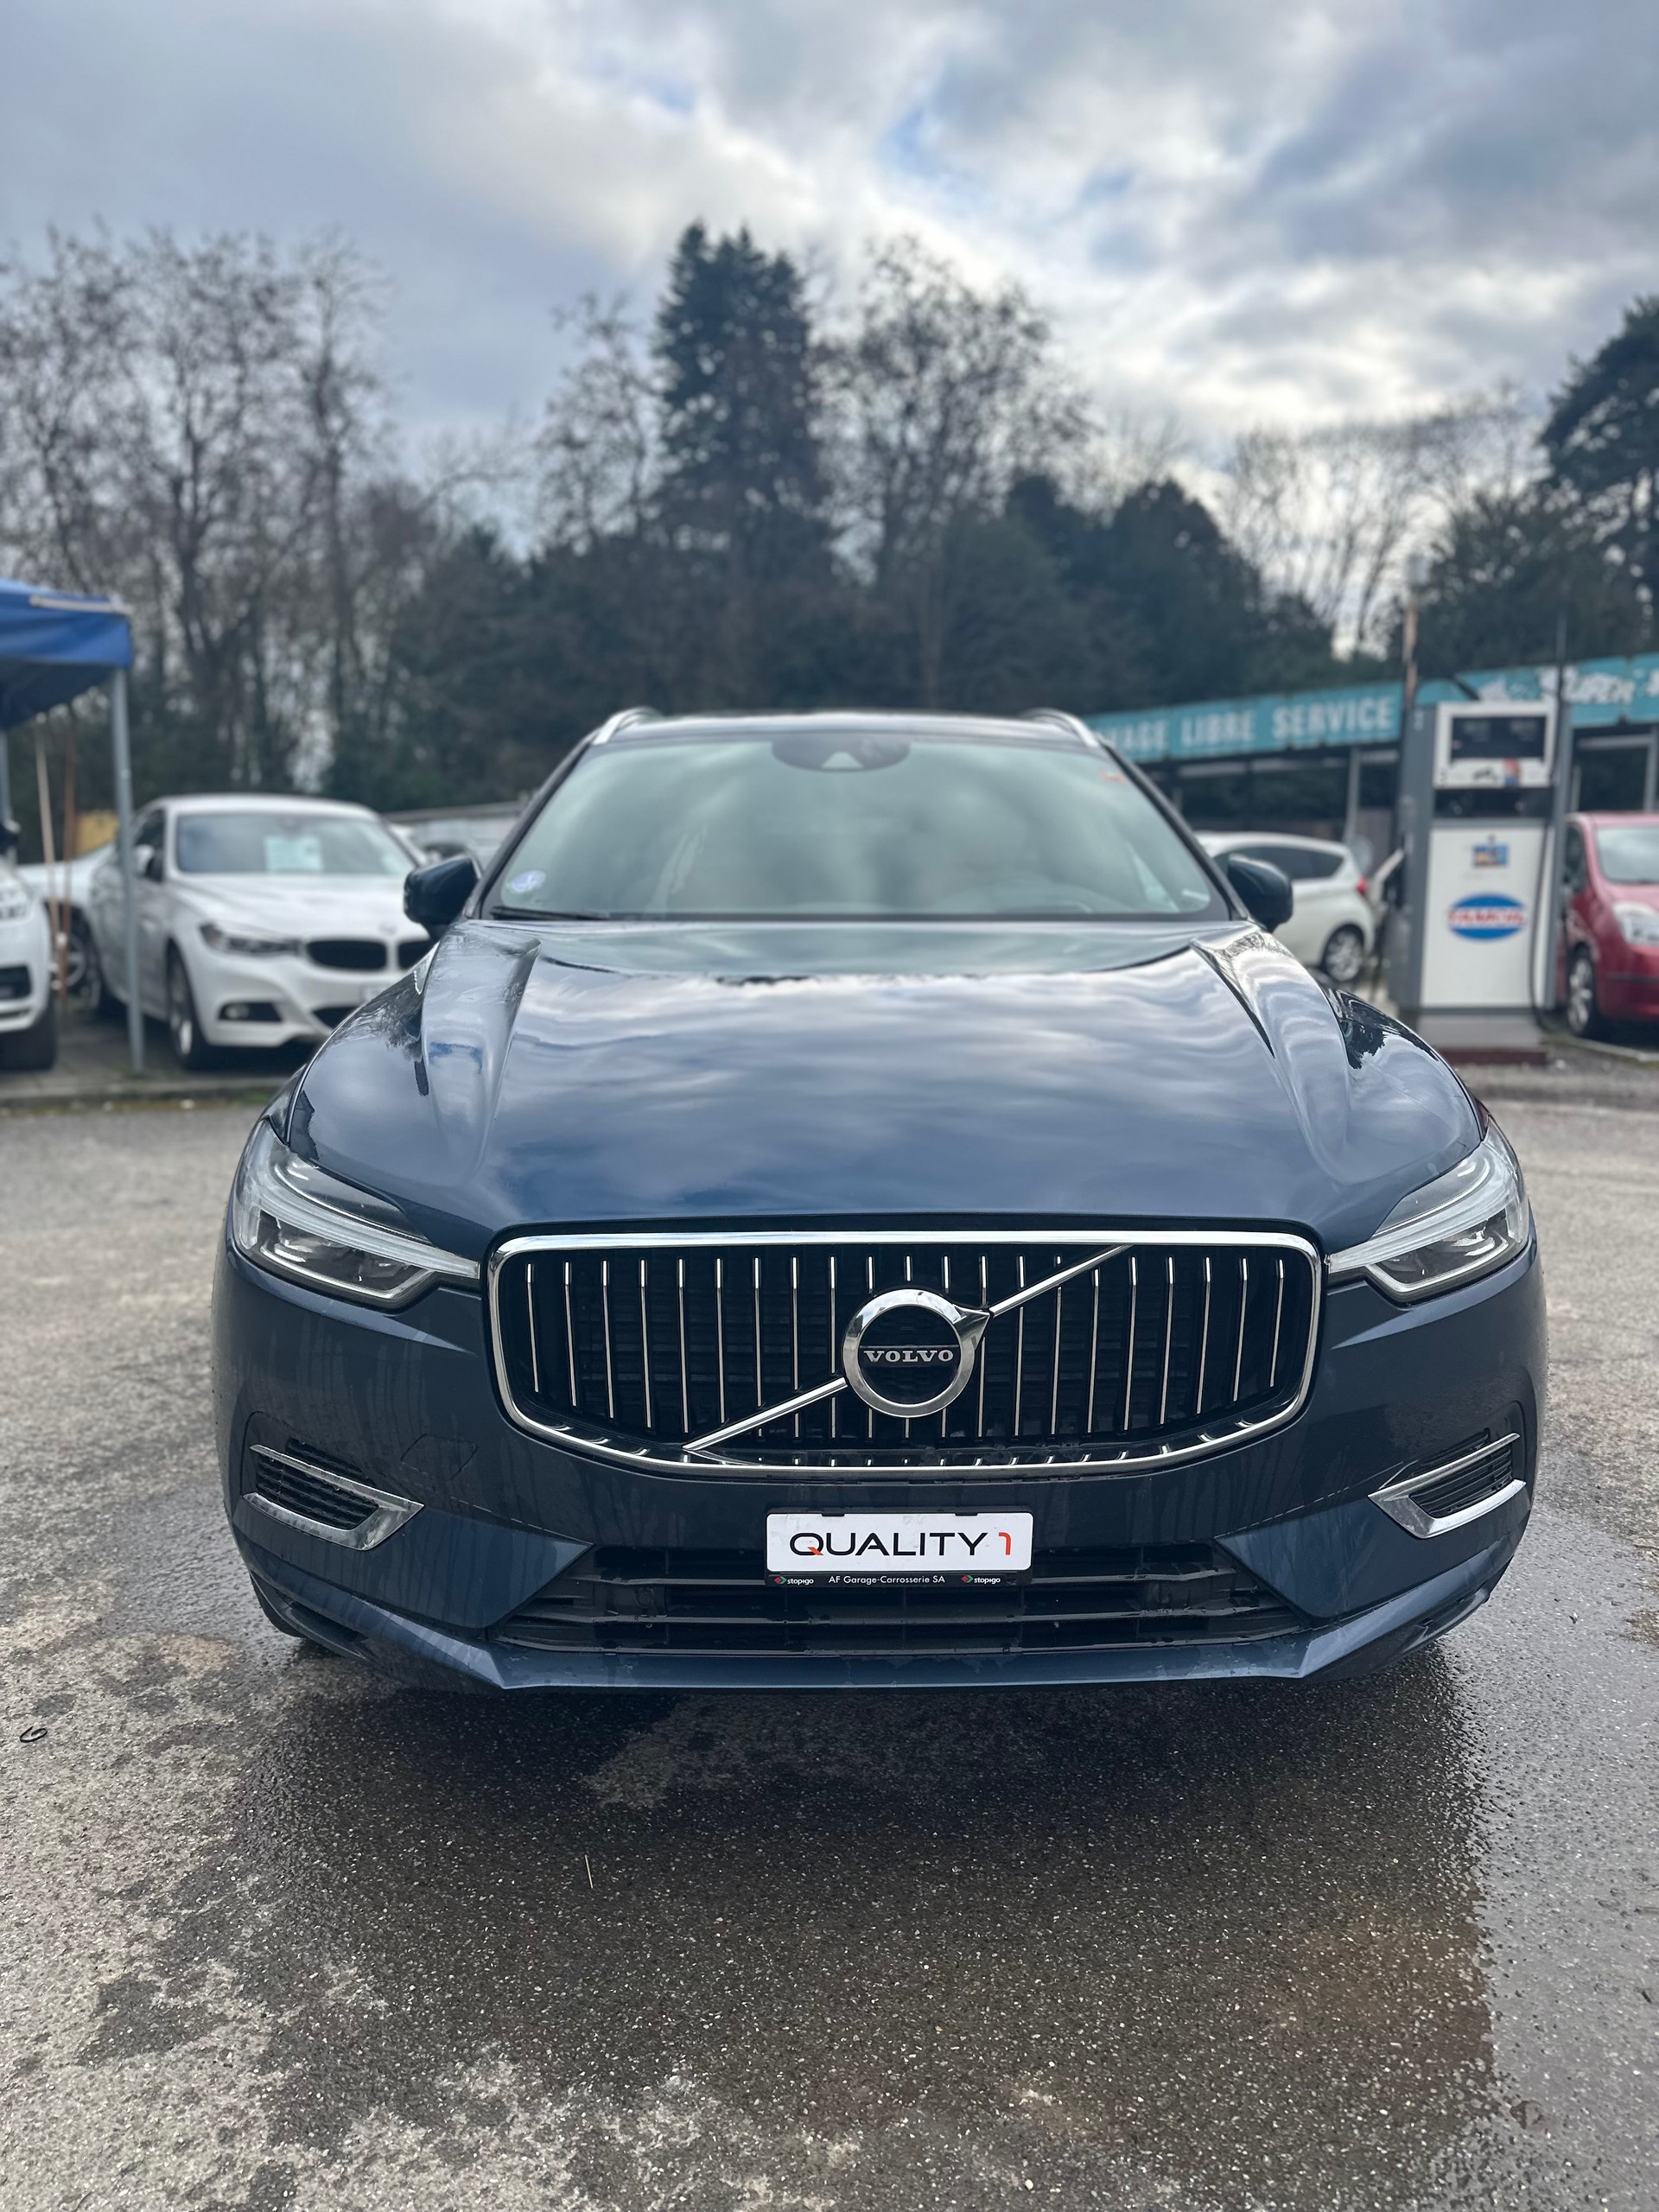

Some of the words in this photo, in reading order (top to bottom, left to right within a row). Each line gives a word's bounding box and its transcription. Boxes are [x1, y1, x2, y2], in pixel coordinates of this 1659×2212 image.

[1180, 709, 1256, 747] LIBRE
[1272, 696, 1394, 741] SERVICE
[863, 1349, 954, 1363] VOLVO
[789, 1532, 988, 1556] QUALITY
[998, 1532, 1012, 1556] 1
[828, 1575, 841, 1584] AF
[842, 1575, 931, 1586] Garage-Carrosserie
[932, 1574, 946, 1584] SA
